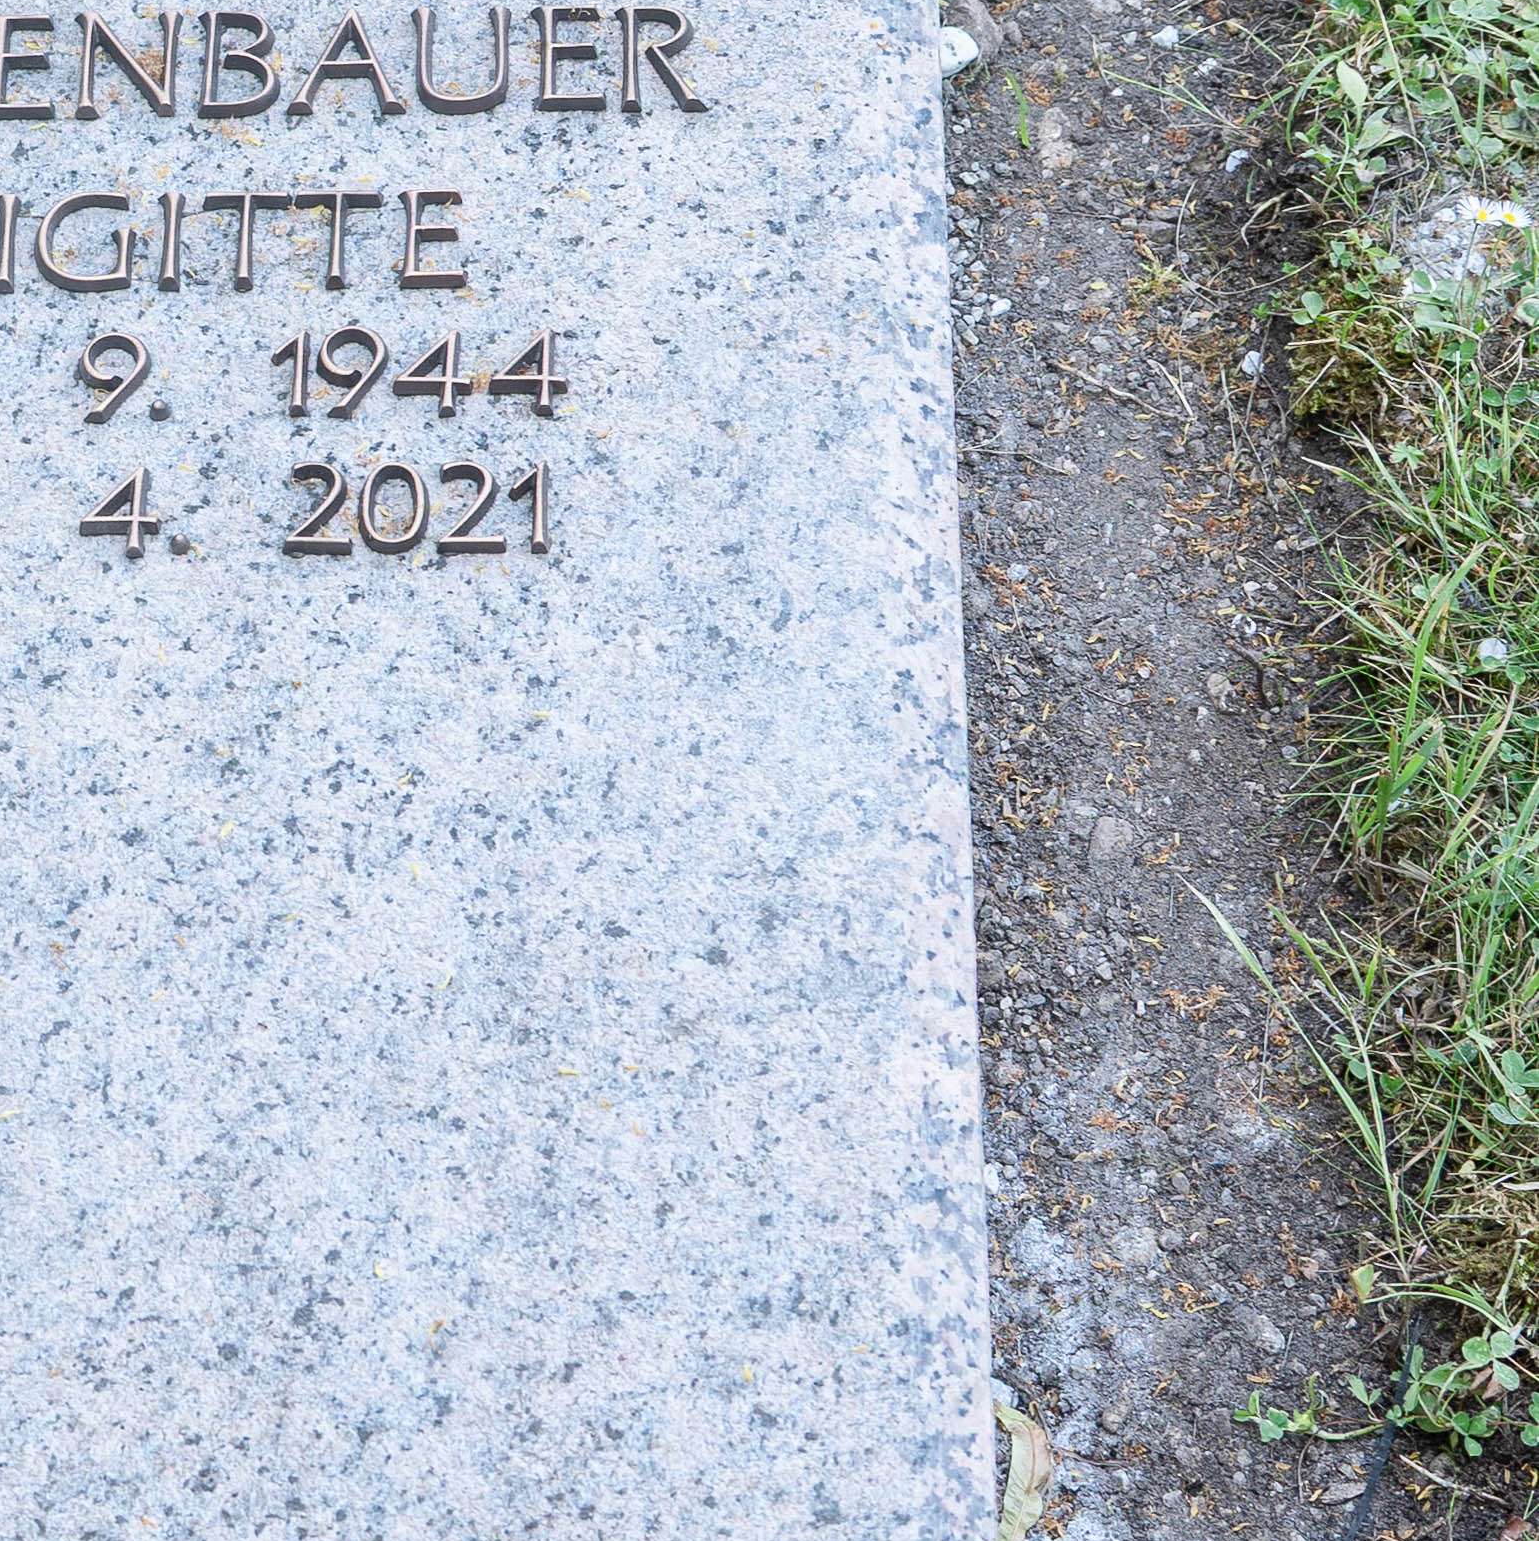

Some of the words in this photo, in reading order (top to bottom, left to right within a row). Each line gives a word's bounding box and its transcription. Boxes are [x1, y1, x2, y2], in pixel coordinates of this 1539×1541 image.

[78, 331, 173, 425] 9.
[273, 324, 570, 420] 1944
[78, 465, 192, 560] 4.
[281, 459, 551, 556] 2021
